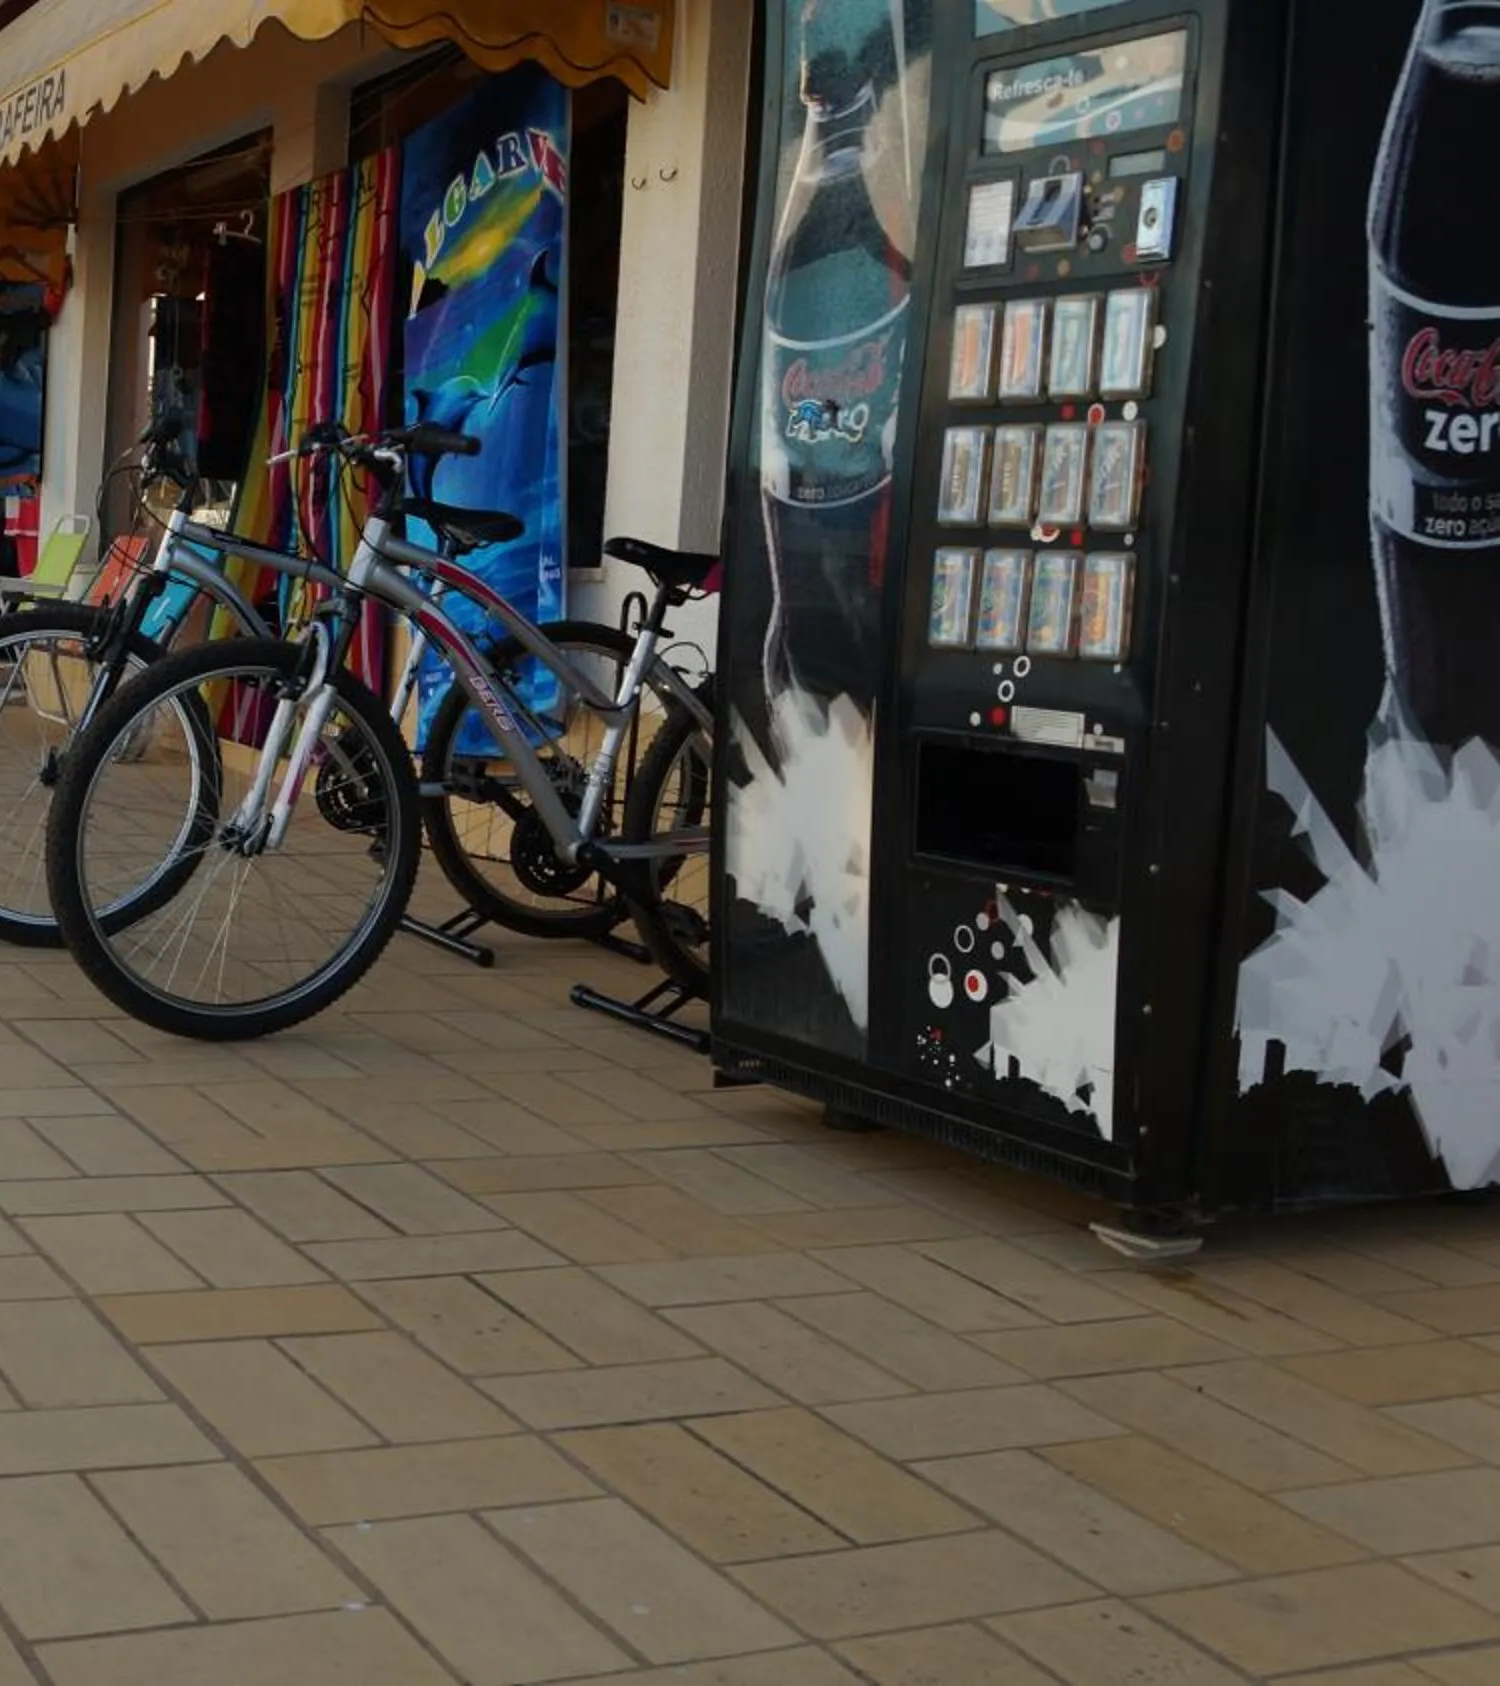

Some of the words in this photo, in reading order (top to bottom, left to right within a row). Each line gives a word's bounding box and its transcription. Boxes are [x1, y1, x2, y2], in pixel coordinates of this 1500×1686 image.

[991, 68, 1086, 101] Refresca-te
[1401, 326, 1500, 407] Coca-C
[1423, 409, 1500, 454] zer
[1471, 495, 1483, 511] o
[1424, 516, 1467, 537] zero
